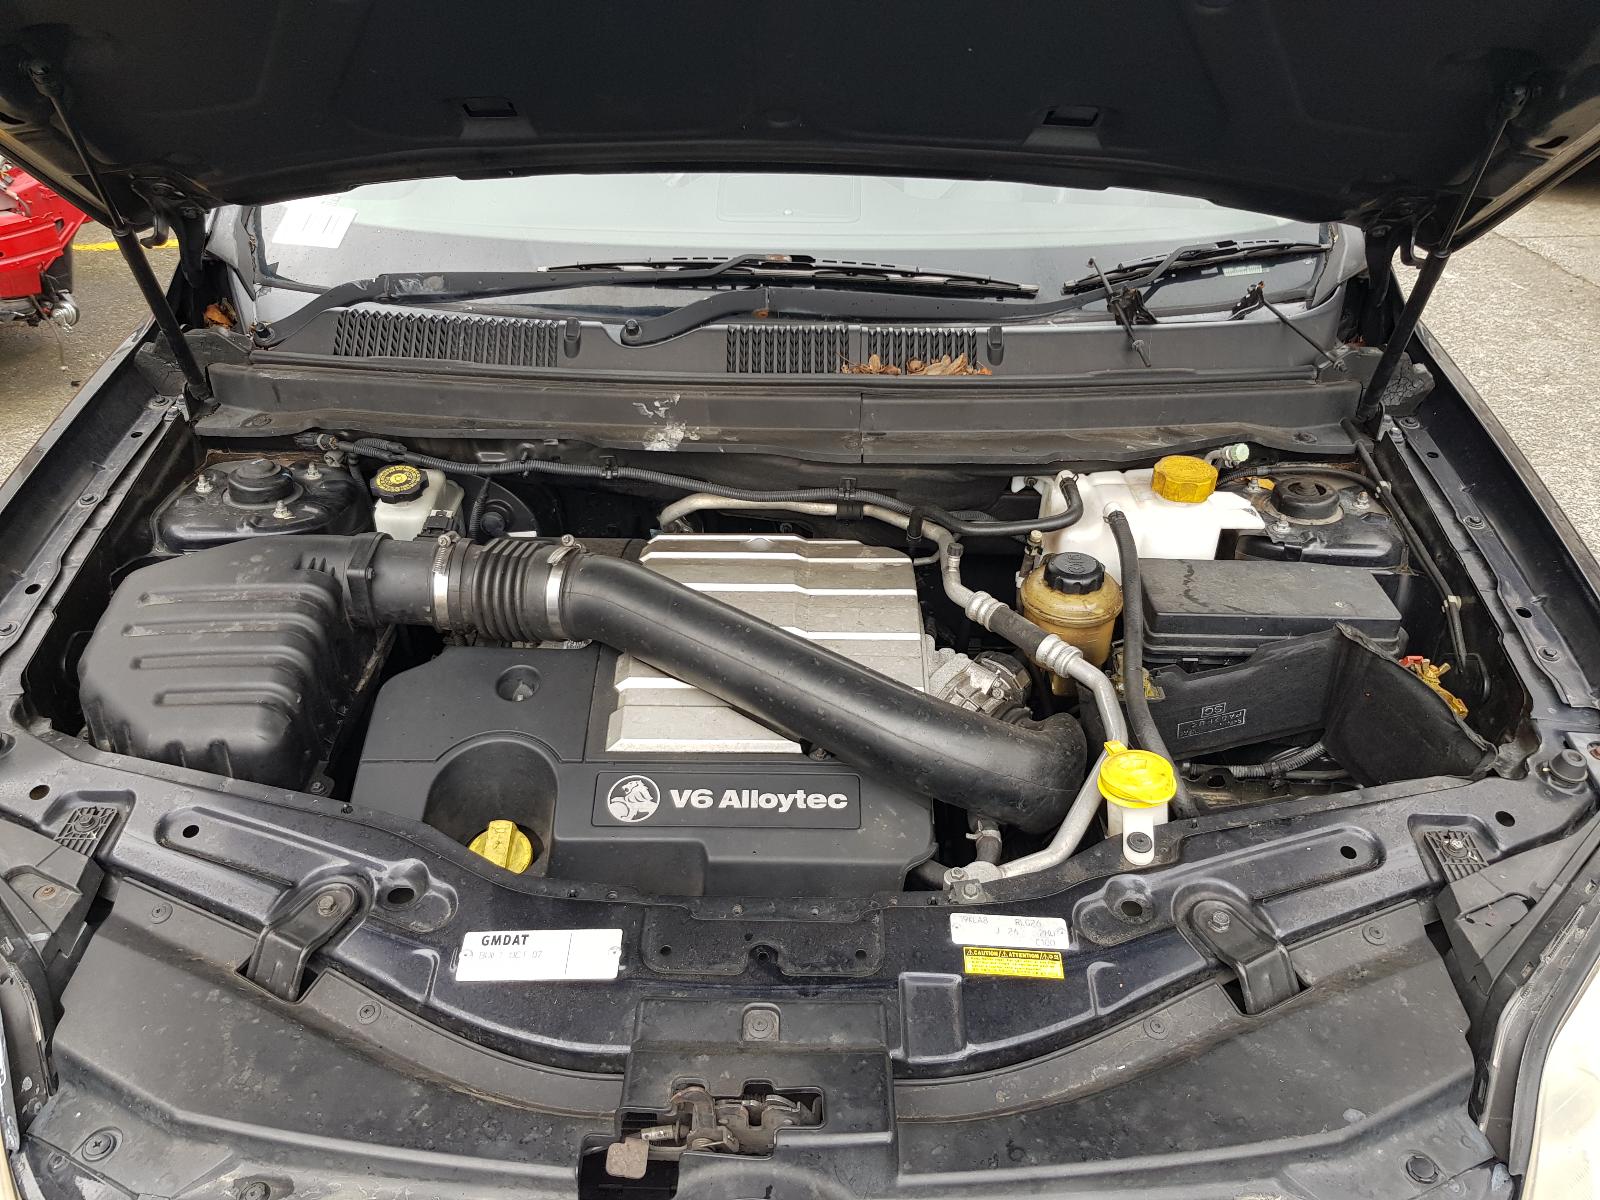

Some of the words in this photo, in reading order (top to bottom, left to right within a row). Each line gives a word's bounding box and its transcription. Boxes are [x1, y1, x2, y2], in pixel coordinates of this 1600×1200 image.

[669, 789, 714, 809] V6
[718, 789, 848, 813] Alloytec
[481, 934, 530, 946] GMDAT
